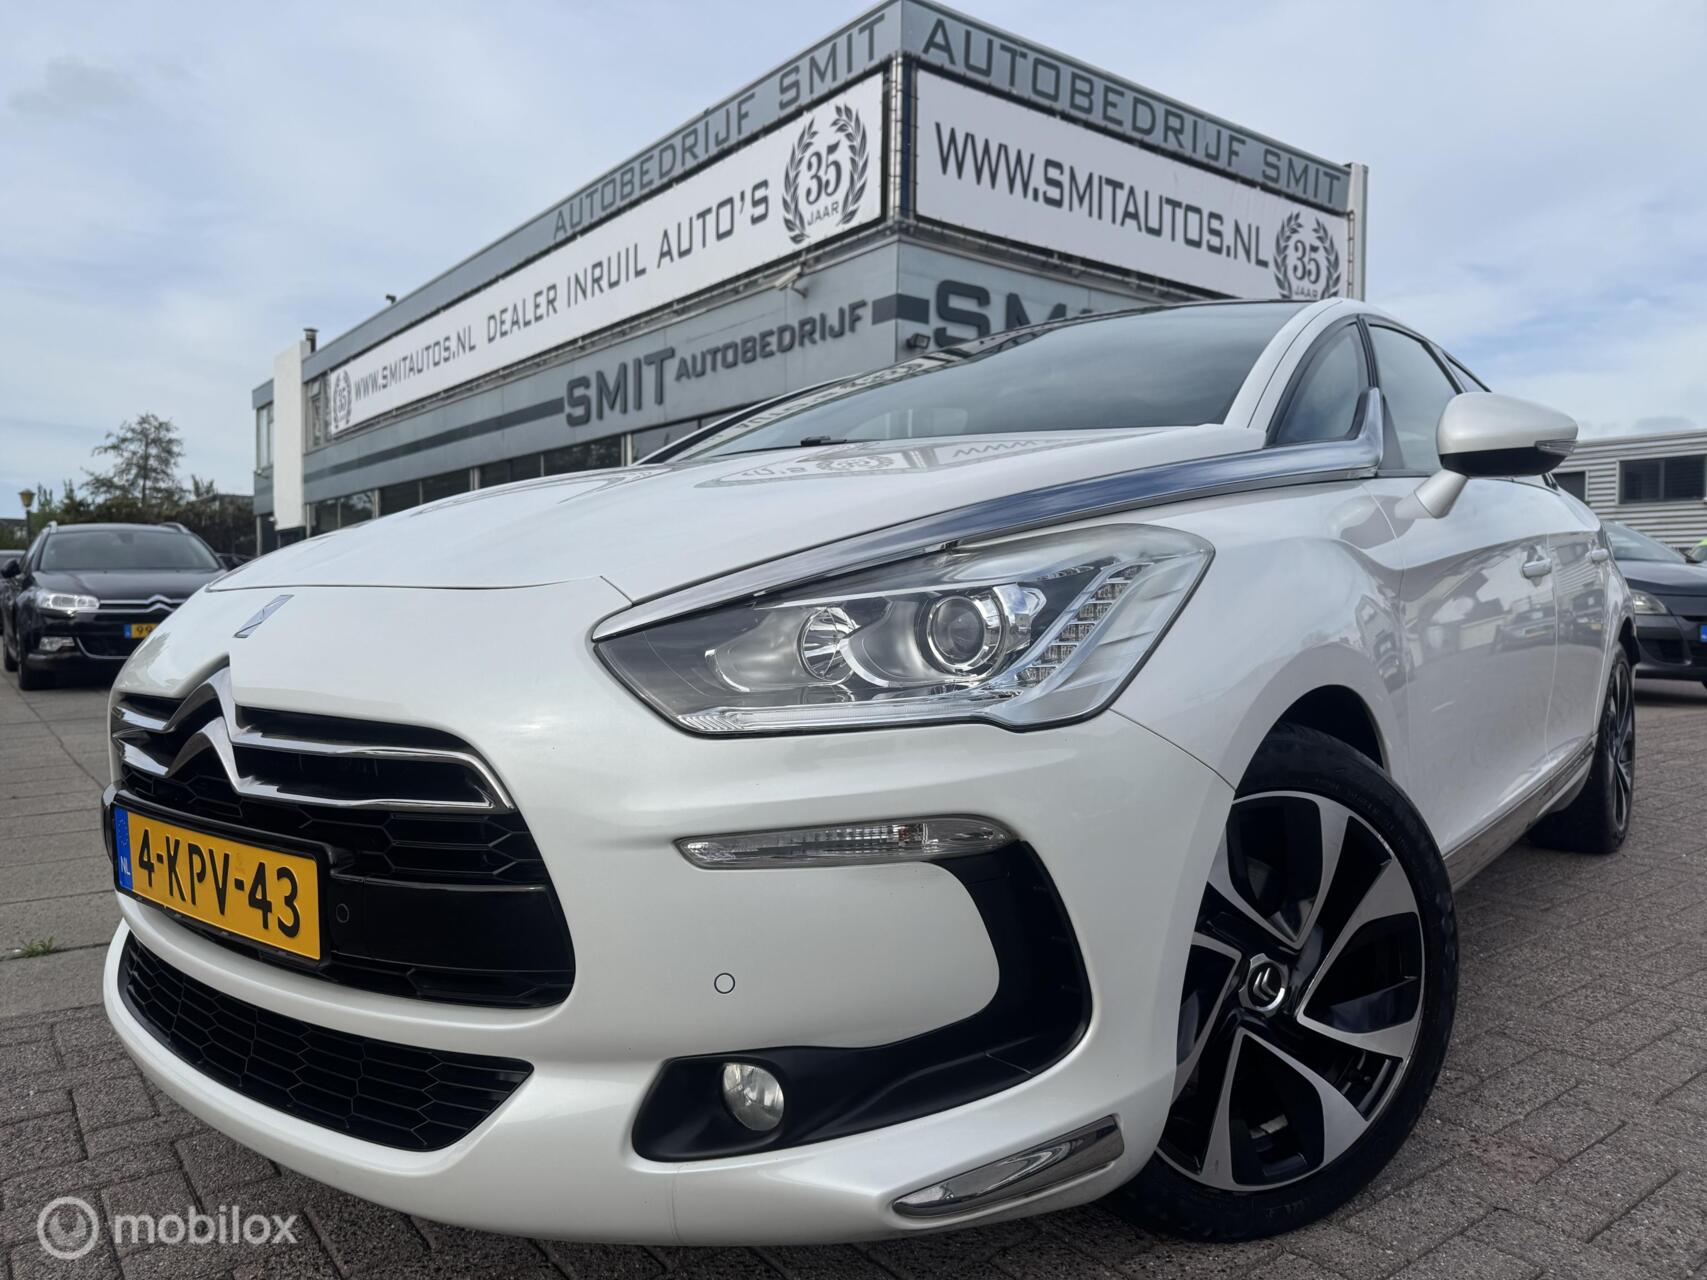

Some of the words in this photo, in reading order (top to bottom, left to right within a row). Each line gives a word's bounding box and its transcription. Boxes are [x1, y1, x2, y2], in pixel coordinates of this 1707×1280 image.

[553, 91, 756, 240] AUTOBEDRIJF
[778, 12, 885, 111] SMIT
[922, 18, 1247, 168] AUTOBEDRIJF
[1261, 147, 1341, 205] SMIT
[805, 140, 842, 205] 35
[807, 200, 840, 227] JAAR
[934, 121, 1269, 269] WWW.SMITAUTOS.NL
[354, 325, 477, 402] WWW.SMITAUTOS.NL
[487, 284, 558, 344] DEALER
[567, 243, 647, 308] INRUIL
[657, 179, 770, 269] AUTO'S
[1293, 239, 1321, 284] 35
[565, 346, 676, 428] SMIT
[674, 300, 868, 382] AUTOBEDRIJF
[120, 855, 132, 876] NL
[138, 828, 301, 938] 4-KPV-43
